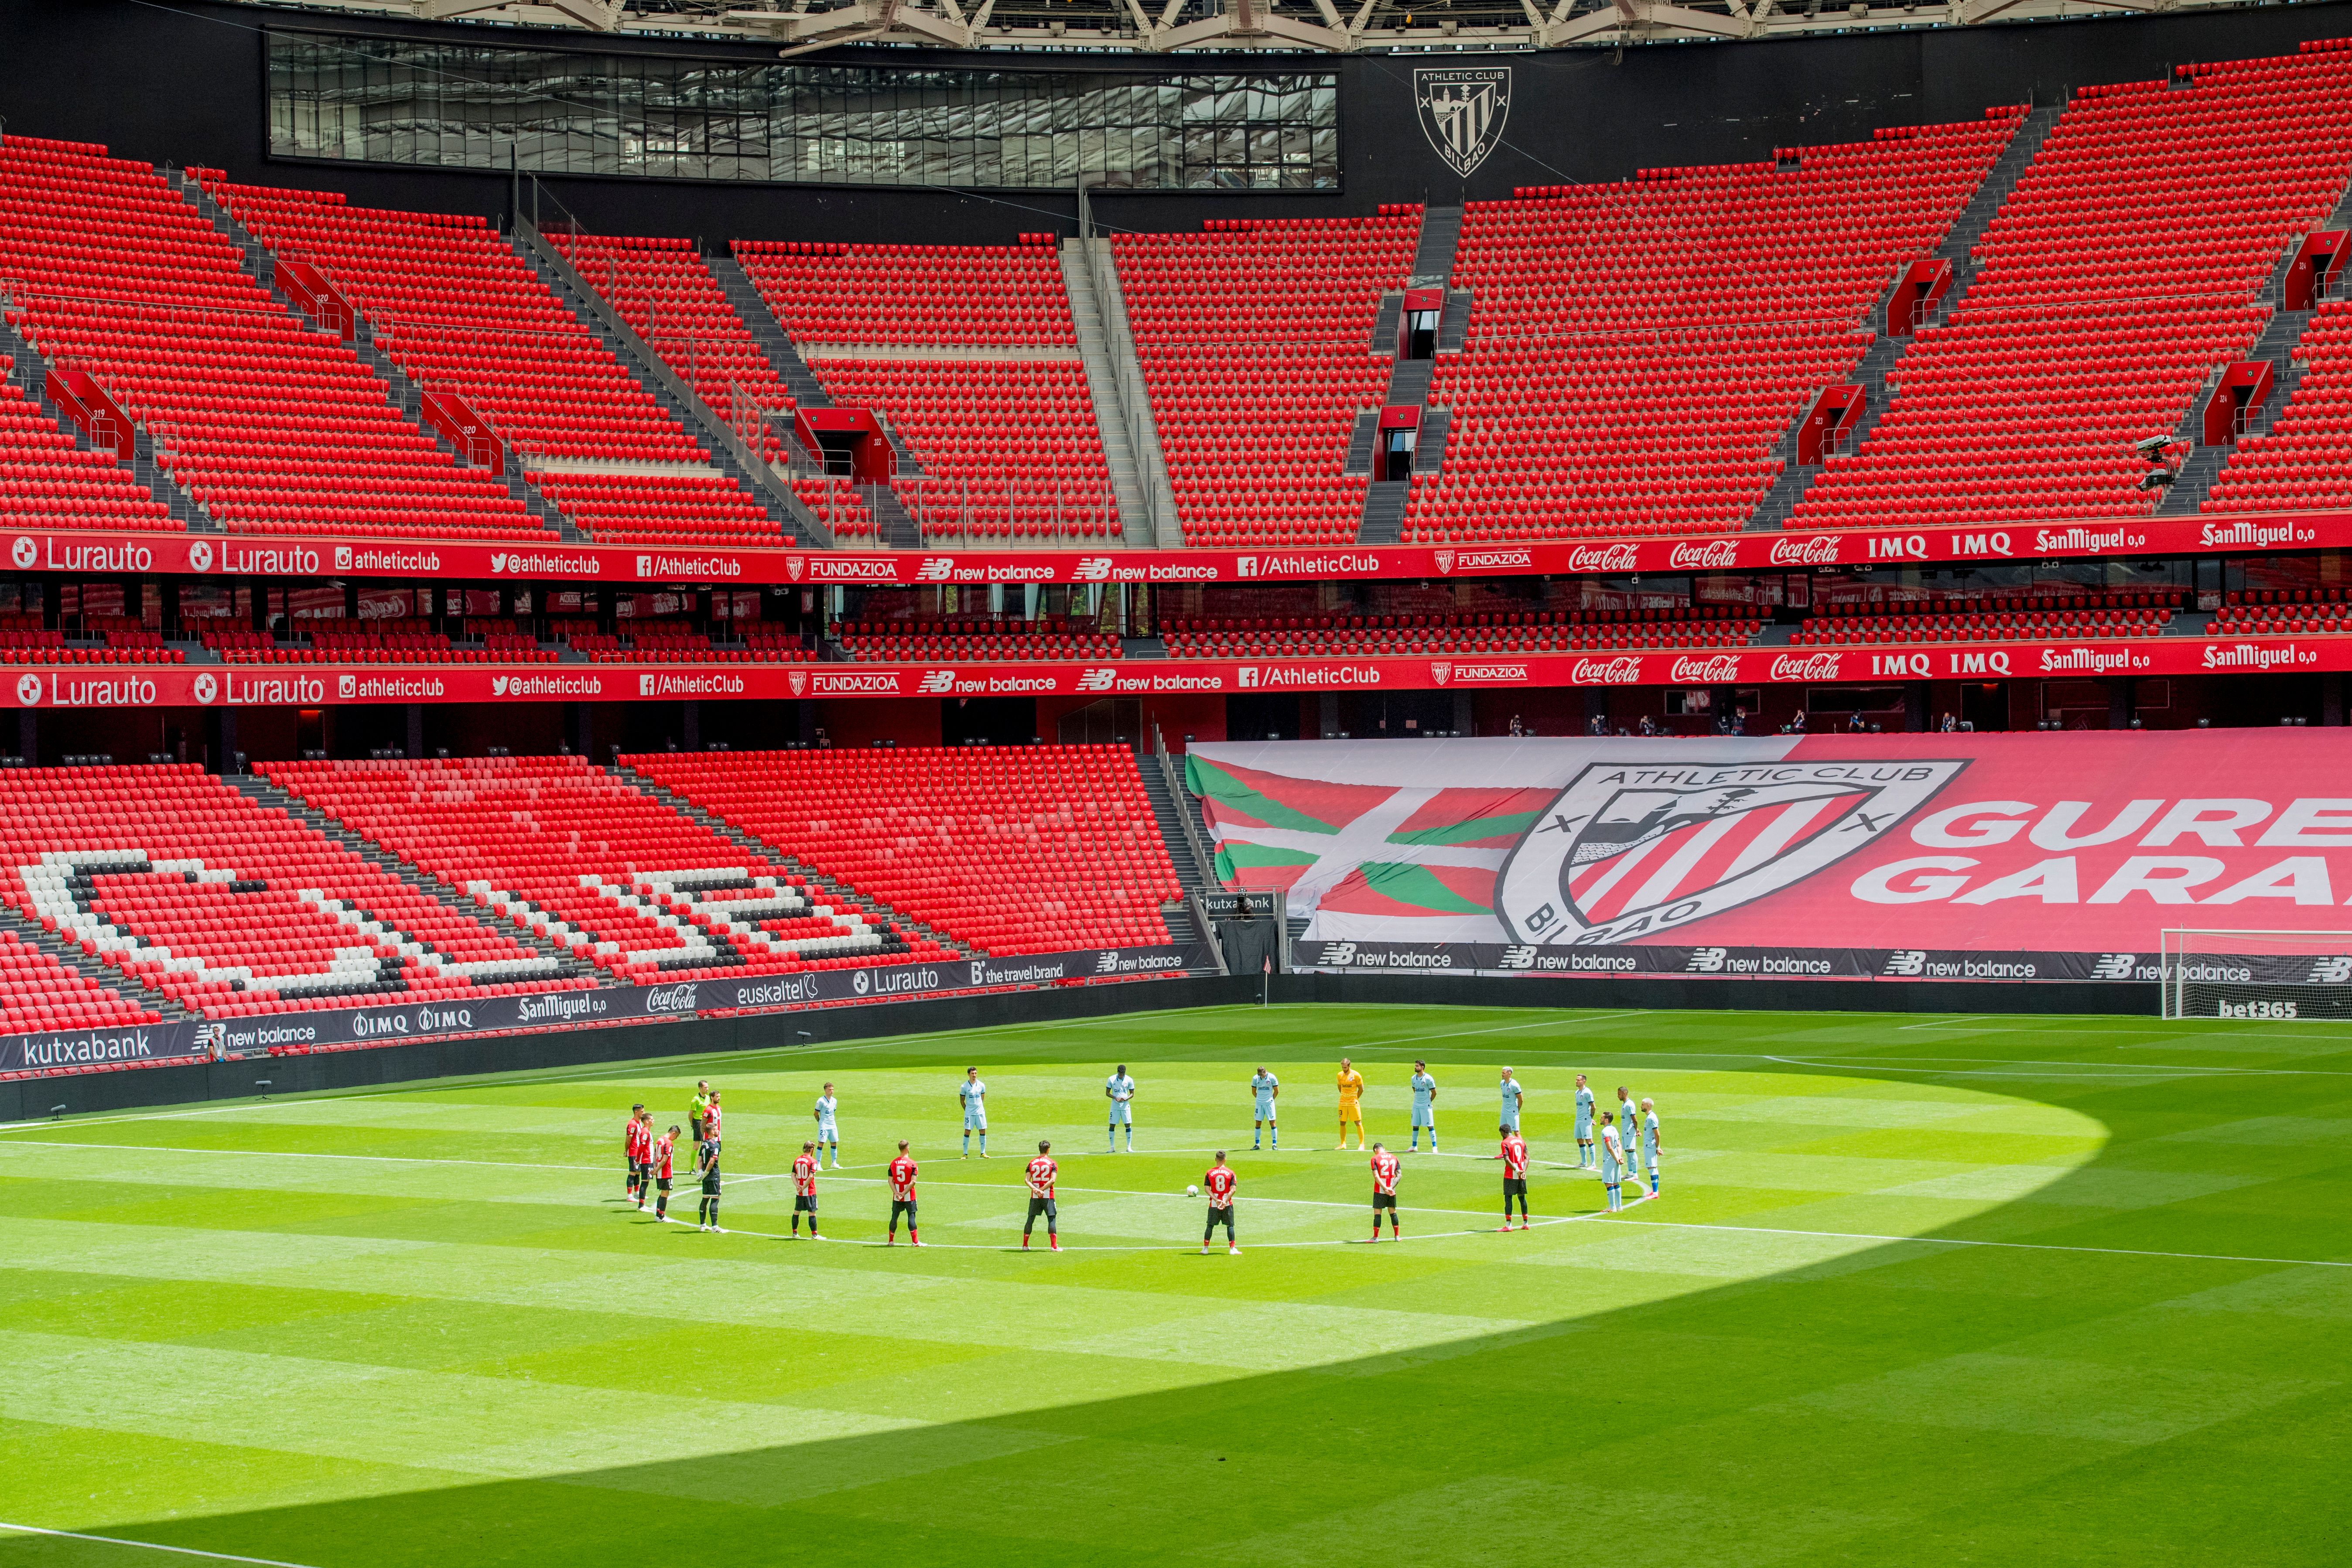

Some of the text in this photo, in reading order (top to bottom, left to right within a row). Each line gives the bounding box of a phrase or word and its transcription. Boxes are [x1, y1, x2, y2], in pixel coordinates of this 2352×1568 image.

[1421, 72, 1504, 81] ATHLETIC CLUB
[1444, 142, 1485, 173] BILBAO
[93, 409, 105, 417] 319
[463, 425, 476, 434] 320
[48, 537, 151, 570] Lurauto
[1670, 540, 1740, 568] Coca-Cola
[1770, 536, 1842, 564] Coca-Cola
[1868, 535, 1928, 559] IMQ
[1952, 532, 2014, 556] IMQ
[222, 541, 319, 573] Lurauto
[355, 550, 440, 570] athleticclub
[508, 554, 599, 574] @athleticclub
[654, 556, 740, 576] /AthleticClub
[1261, 554, 1379, 576] /AthleticClub
[1459, 553, 1531, 566] FUNDAZIOA
[1569, 544, 1640, 571] Coca-Cola
[811, 563, 897, 577] FUNDAZIOA
[954, 568, 985, 580] new
[988, 565, 1054, 580] balance
[1113, 568, 1146, 580] new
[1150, 564, 1218, 579] balance
[1455, 667, 1527, 678] FUNDAZIOA
[1572, 656, 1643, 684] Coca-Cola
[1671, 655, 1741, 682] Coca-Cola
[1771, 653, 1843, 680] Coca-Cola
[1873, 653, 1932, 677] IMQ
[1951, 651, 2012, 675] IMQ
[509, 676, 601, 696] @athleticclub
[657, 674, 744, 695] /AthleticClub
[813, 676, 899, 691] FUNDAZIOA
[956, 680, 986, 692] new
[990, 676, 1056, 692] balance
[1117, 678, 1150, 690] new
[1154, 675, 1222, 690] balance
[1261, 666, 1380, 687] /AthleticClub
[52, 673, 156, 705] Lurauto
[227, 673, 323, 703] Lurauto
[359, 677, 444, 697] athleticclub
[1597, 766, 1934, 786] ATHLETIC CLUB
[1911, 798, 2352, 851] GURE
[1850, 855, 2352, 905] GARA
[1525, 901, 1702, 945] BILBAO
[1118, 959, 1138, 971] new
[1138, 955, 1182, 969] balance
[1357, 953, 1387, 967] new
[1389, 951, 1451, 967] balance
[1538, 957, 1569, 969] new
[1572, 953, 1636, 970] balance
[1727, 959, 1760, 972] new
[1763, 956, 1831, 973] balance
[1927, 963, 1961, 976] new
[1965, 960, 2036, 977] balance
[874, 967, 938, 993] Lurauto
[986, 969, 1003, 984] the
[1004, 965, 1033, 982] travel
[1034, 963, 1063, 980] brand
[2136, 966, 2172, 979] new
[2177, 963, 2251, 981] balance
[646, 984, 698, 1013] Coca-Cola
[737, 979, 803, 1005] euskaltel
[434, 1010, 473, 1028] IMQ
[2219, 1000, 2297, 1018] bet365
[369, 1015, 409, 1034] IMQ
[227, 1033, 256, 1047] new
[260, 1026, 316, 1046] balance
[24, 1029, 150, 1065] kutxabank
[656, 1144, 662, 1161] 14
[701, 1148, 706, 1164] 1
[1514, 1144, 1522, 1161] 9
[795, 1163, 808, 1179] 10
[896, 1165, 906, 1182] 5
[1031, 1165, 1050, 1182] 22
[1380, 1159, 1396, 1176] 21
[1215, 1175, 1226, 1192] 8
